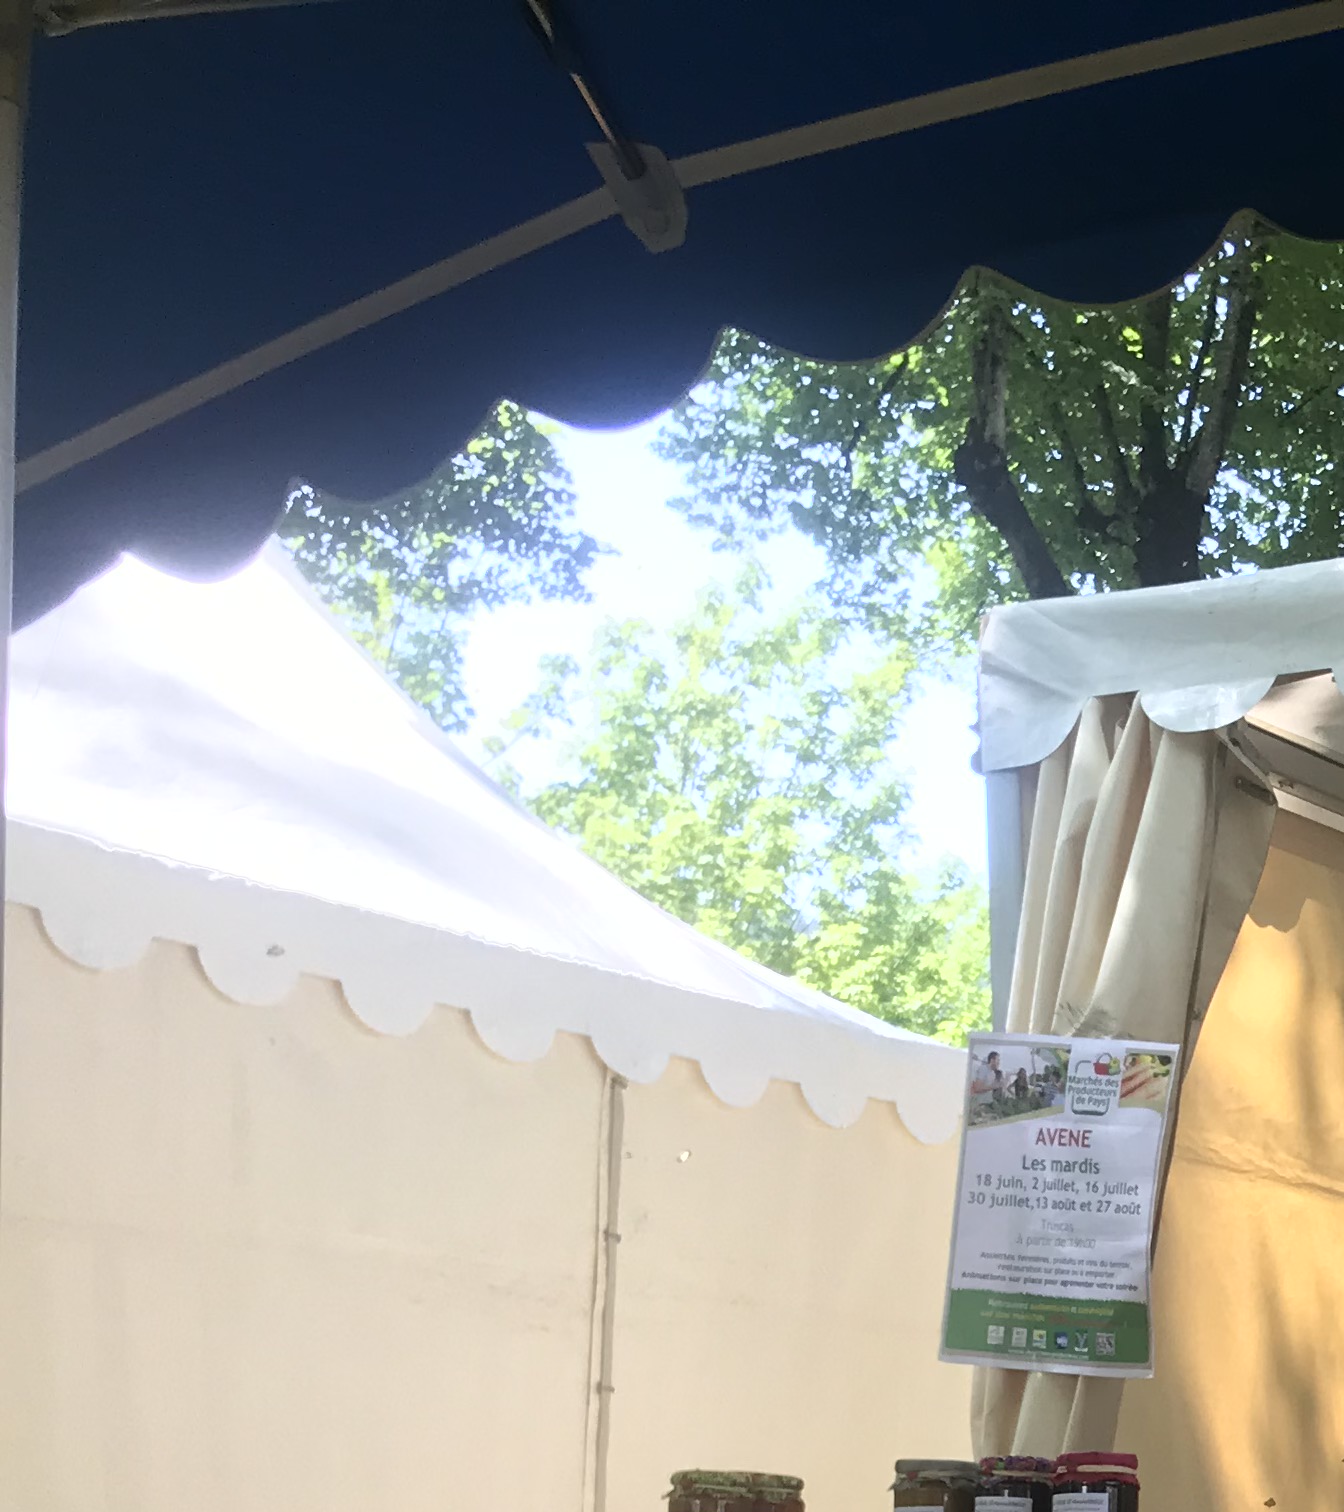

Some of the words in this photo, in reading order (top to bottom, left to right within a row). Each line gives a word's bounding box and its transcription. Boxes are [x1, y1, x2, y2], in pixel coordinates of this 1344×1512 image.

[1035, 1127, 1094, 1149] AVENE
[1022, 1154, 1047, 1172] Les
[1050, 1157, 1101, 1175] mardis
[976, 1173, 993, 1188] 18
[995, 1174, 1028, 1192] juin,
[1032, 1176, 1040, 1190] 2
[1041, 1178, 1080, 1195] juillet,
[1086, 1181, 1099, 1194] 16
[1102, 1182, 1140, 1198] juillet
[968, 1191, 986, 1205] 30
[1051, 1197, 1077, 1211] août
[1080, 1199, 1093, 1212] et
[1095, 1199, 1112, 1213] 27
[1114, 1202, 1142, 1216] août
